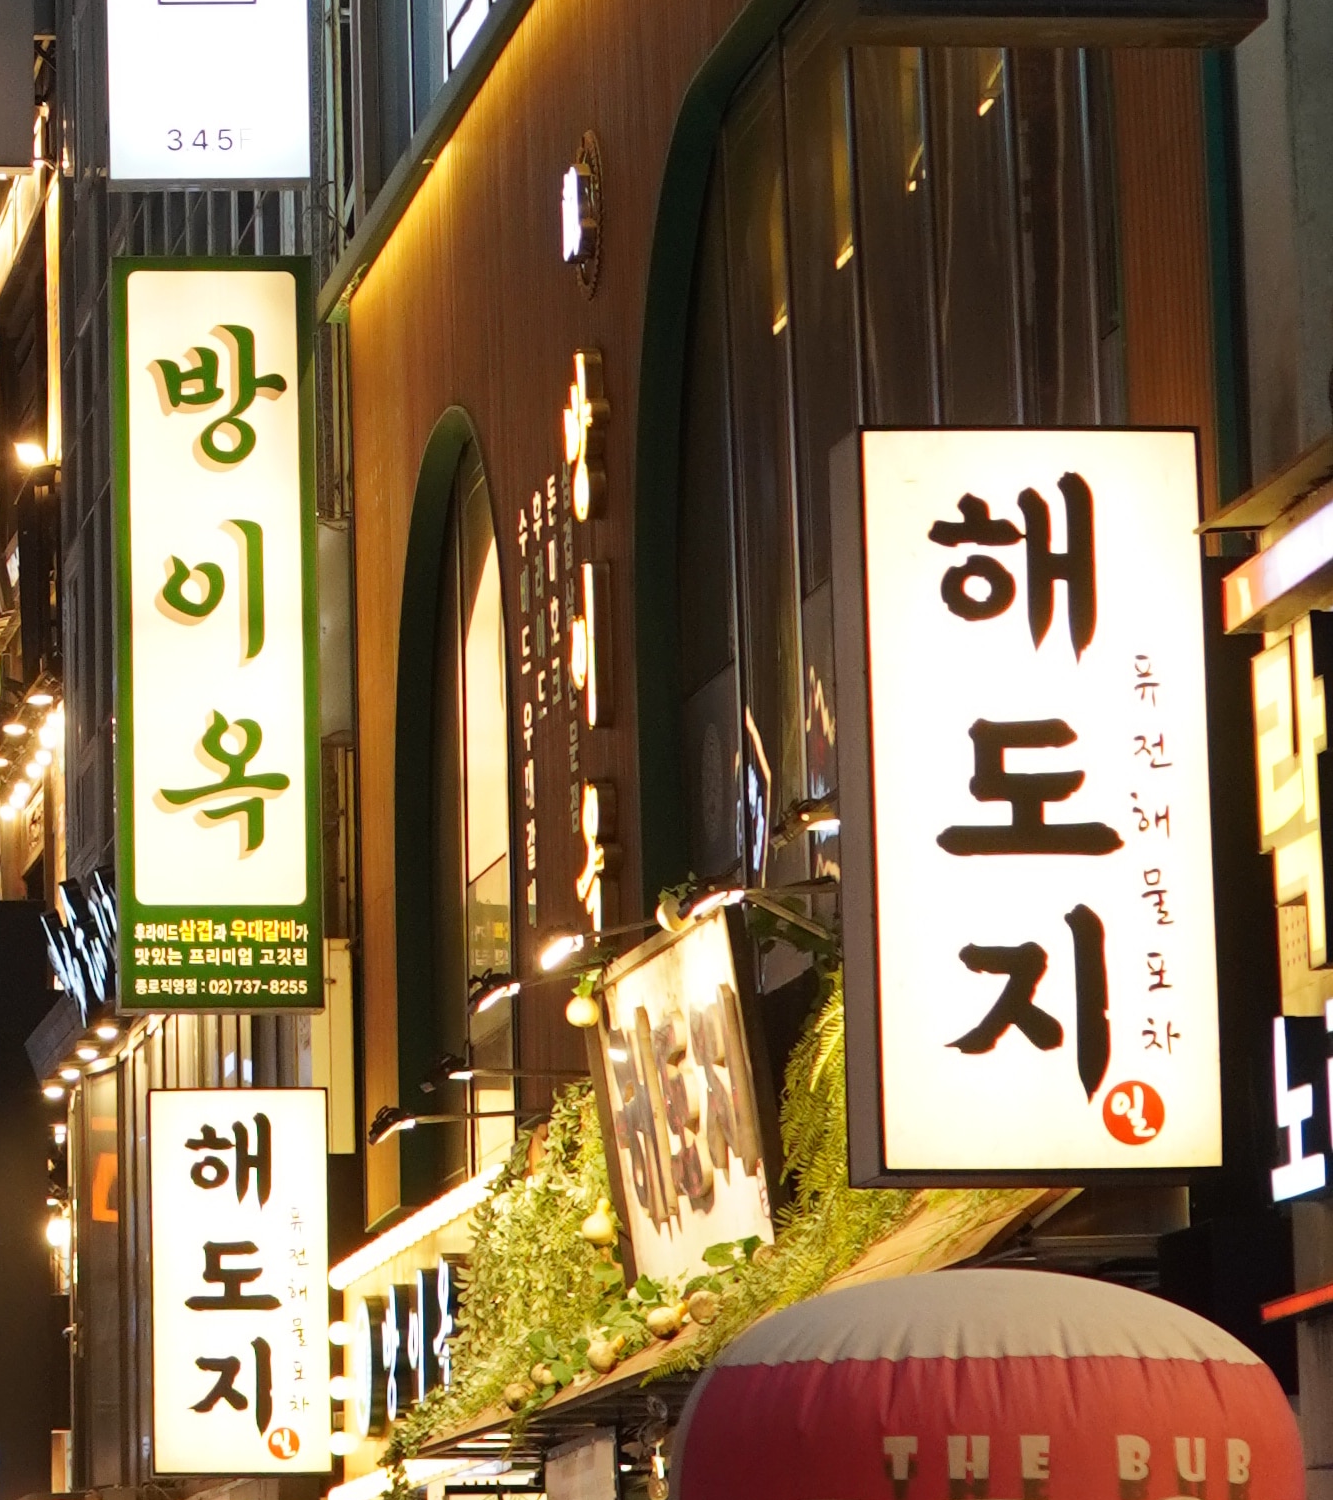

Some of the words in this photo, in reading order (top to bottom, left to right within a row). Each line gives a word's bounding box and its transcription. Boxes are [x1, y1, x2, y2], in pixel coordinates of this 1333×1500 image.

[151, 324, 290, 856] 방이옥
[927, 471, 1124, 1104] 해도지
[134, 948, 183, 966] 맛있는
[189, 948, 253, 966] 프리미엄
[260, 948, 308, 966] 고깃집
[208, 979, 308, 996] 02)737-8255
[184, 1112, 283, 1438] 해도지
[882, 1434, 1051, 1481] THE
[1116, 1434, 1252, 1486] BUB
